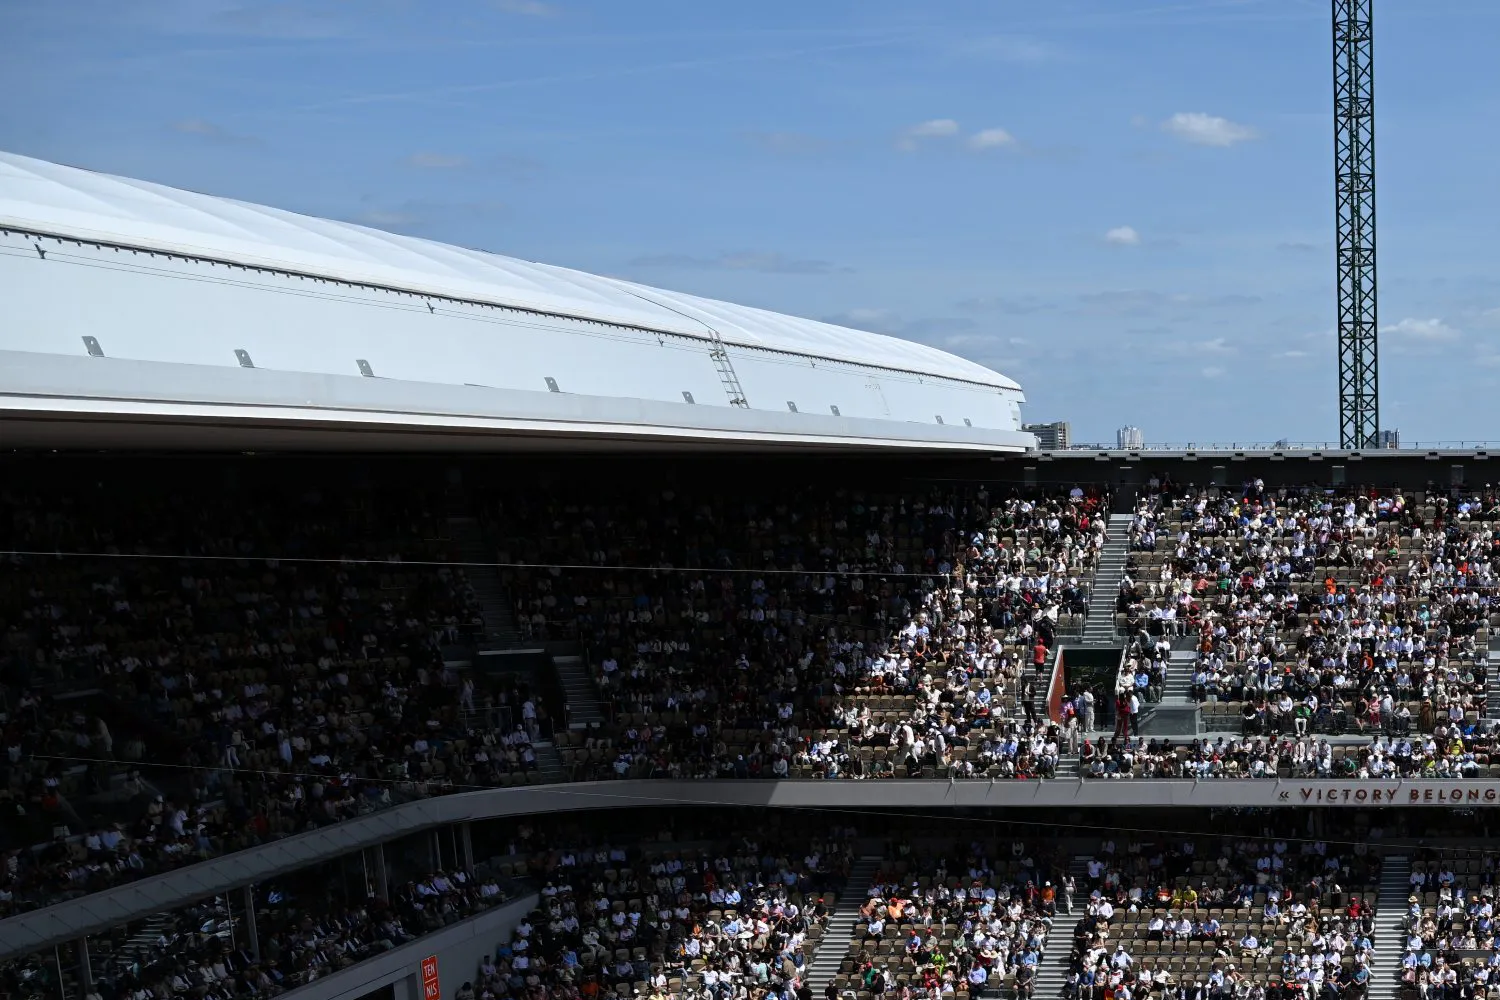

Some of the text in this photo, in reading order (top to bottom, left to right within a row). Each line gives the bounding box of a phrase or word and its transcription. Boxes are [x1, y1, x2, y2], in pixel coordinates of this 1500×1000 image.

[1300, 788, 1397, 800] VICTORY
[424, 963, 435, 977] TEN
[426, 982, 437, 998] NIS
